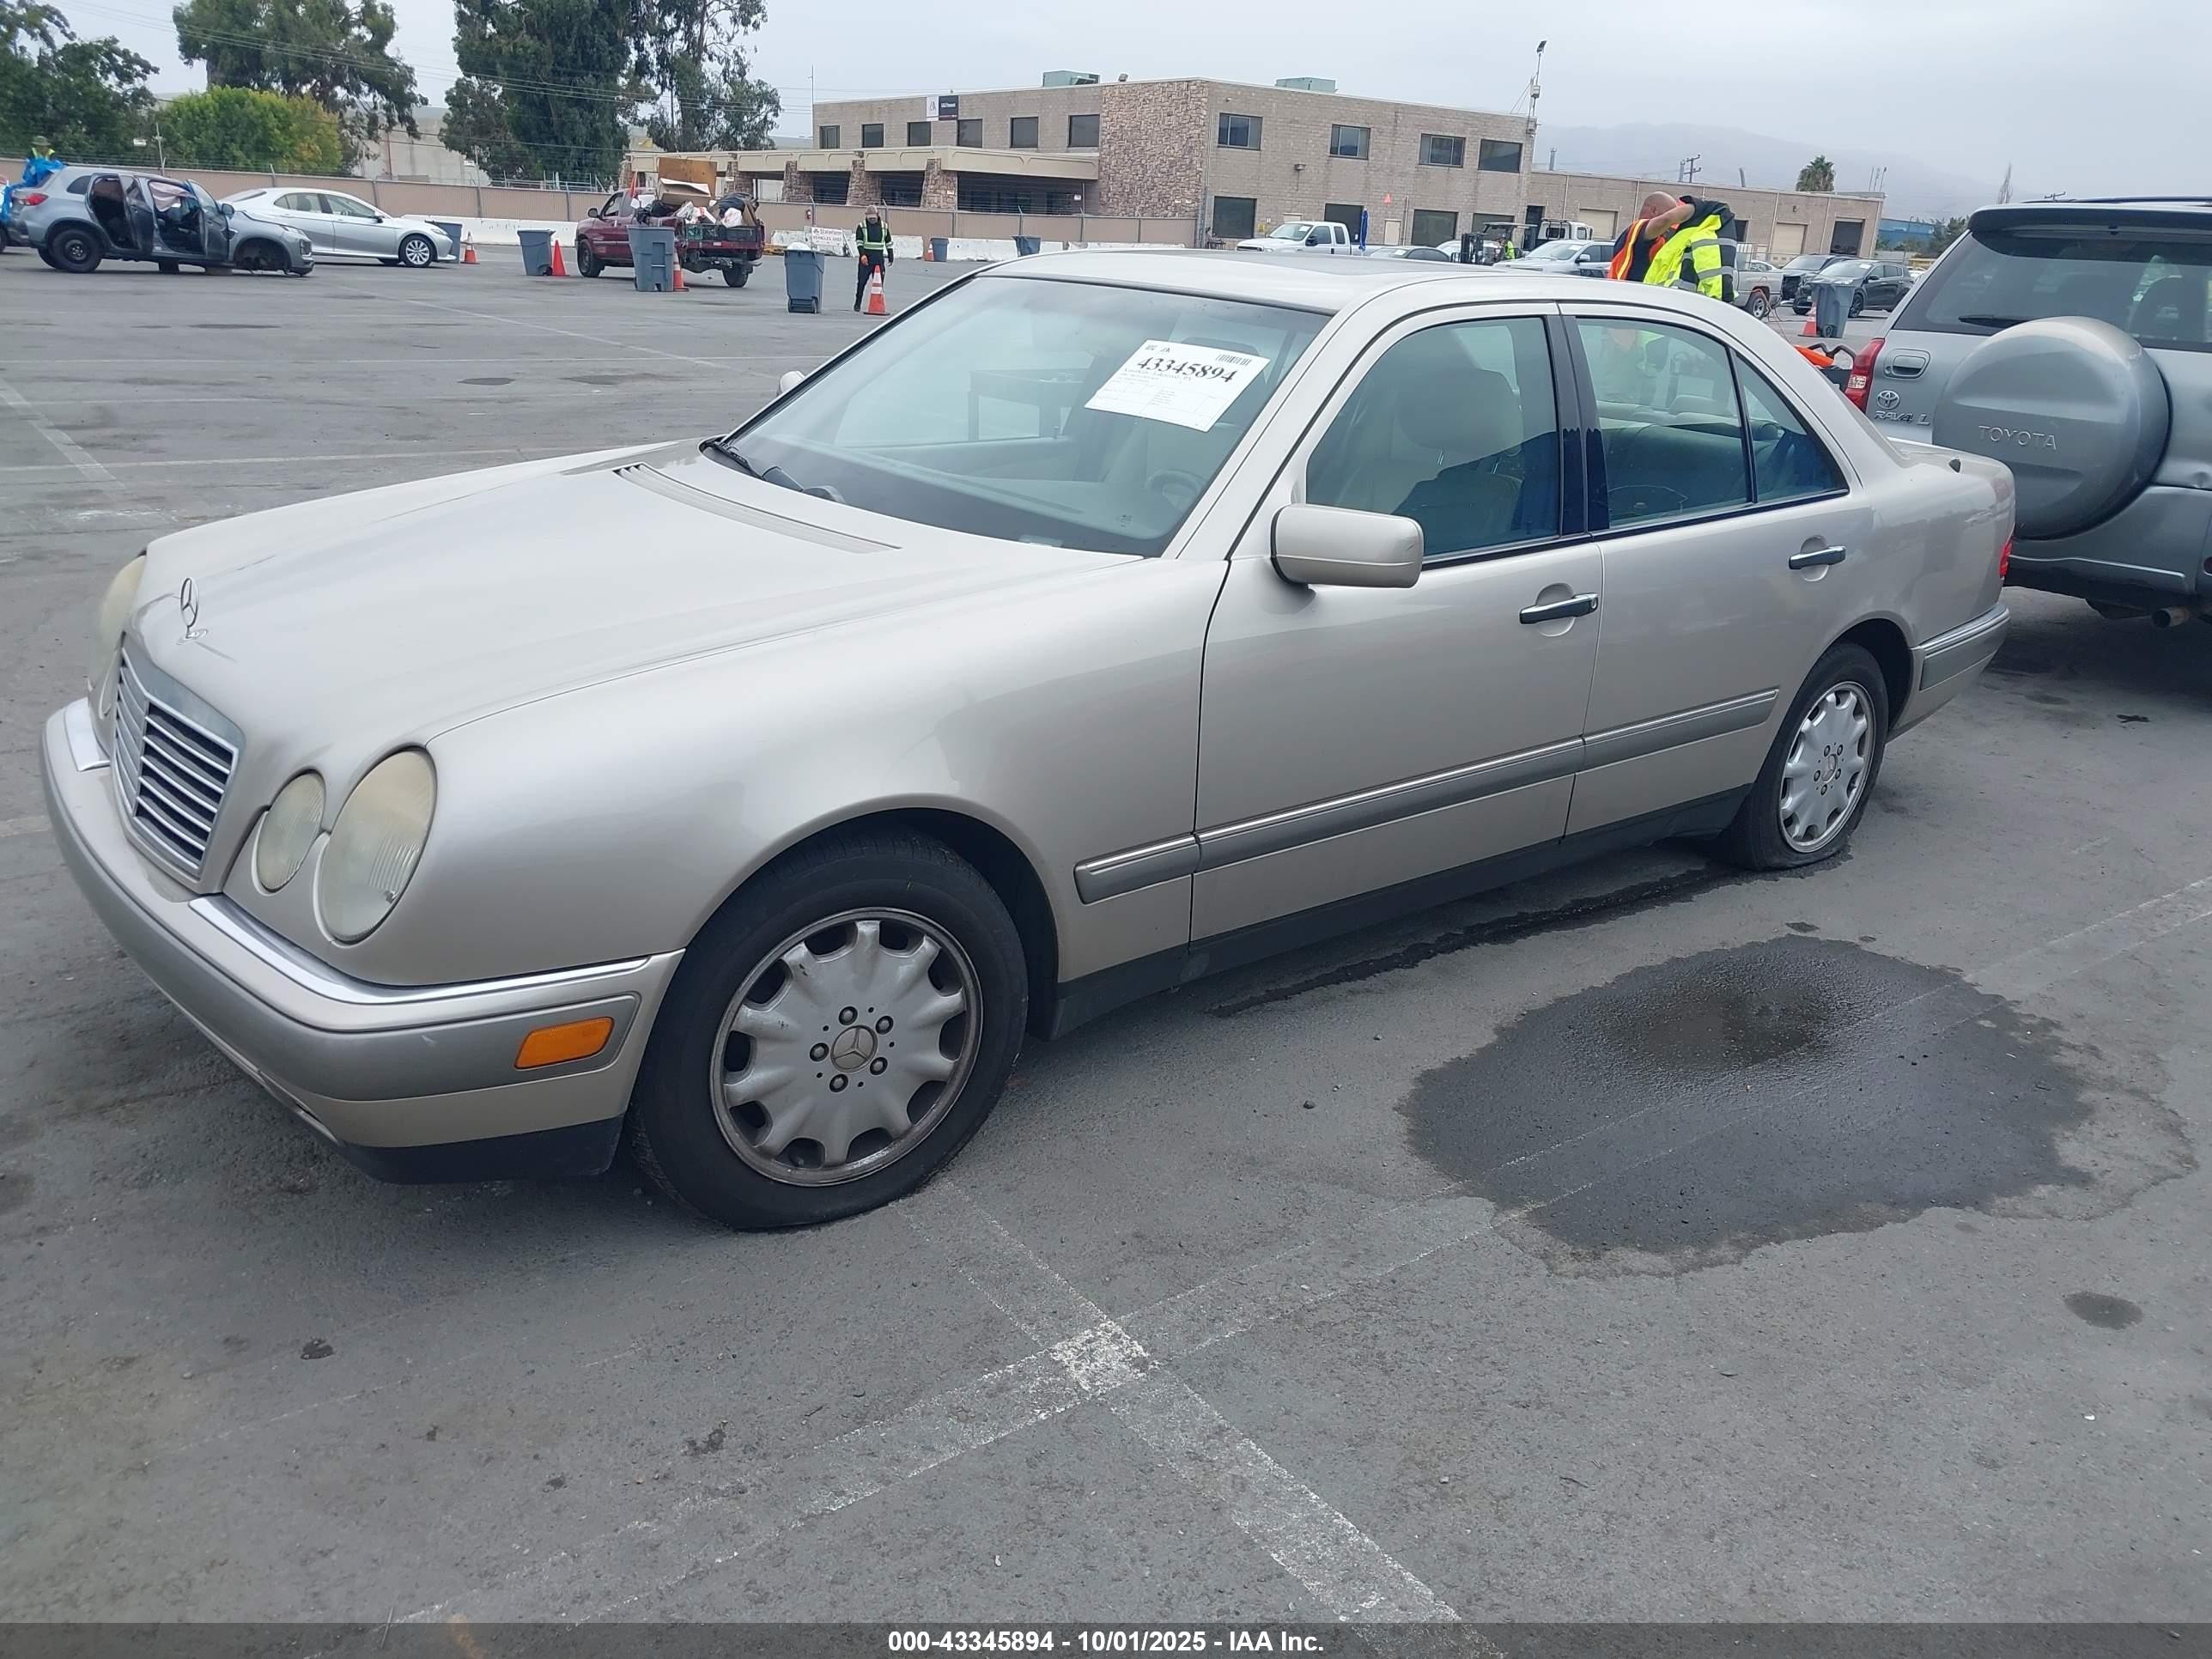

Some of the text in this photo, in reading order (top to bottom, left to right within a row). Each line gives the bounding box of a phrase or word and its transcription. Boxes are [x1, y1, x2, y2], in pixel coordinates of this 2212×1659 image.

[1137, 356, 1238, 383] 43345894
[1875, 410, 1931, 426] RAV4 L
[1978, 424, 2057, 452] TOYOTA
